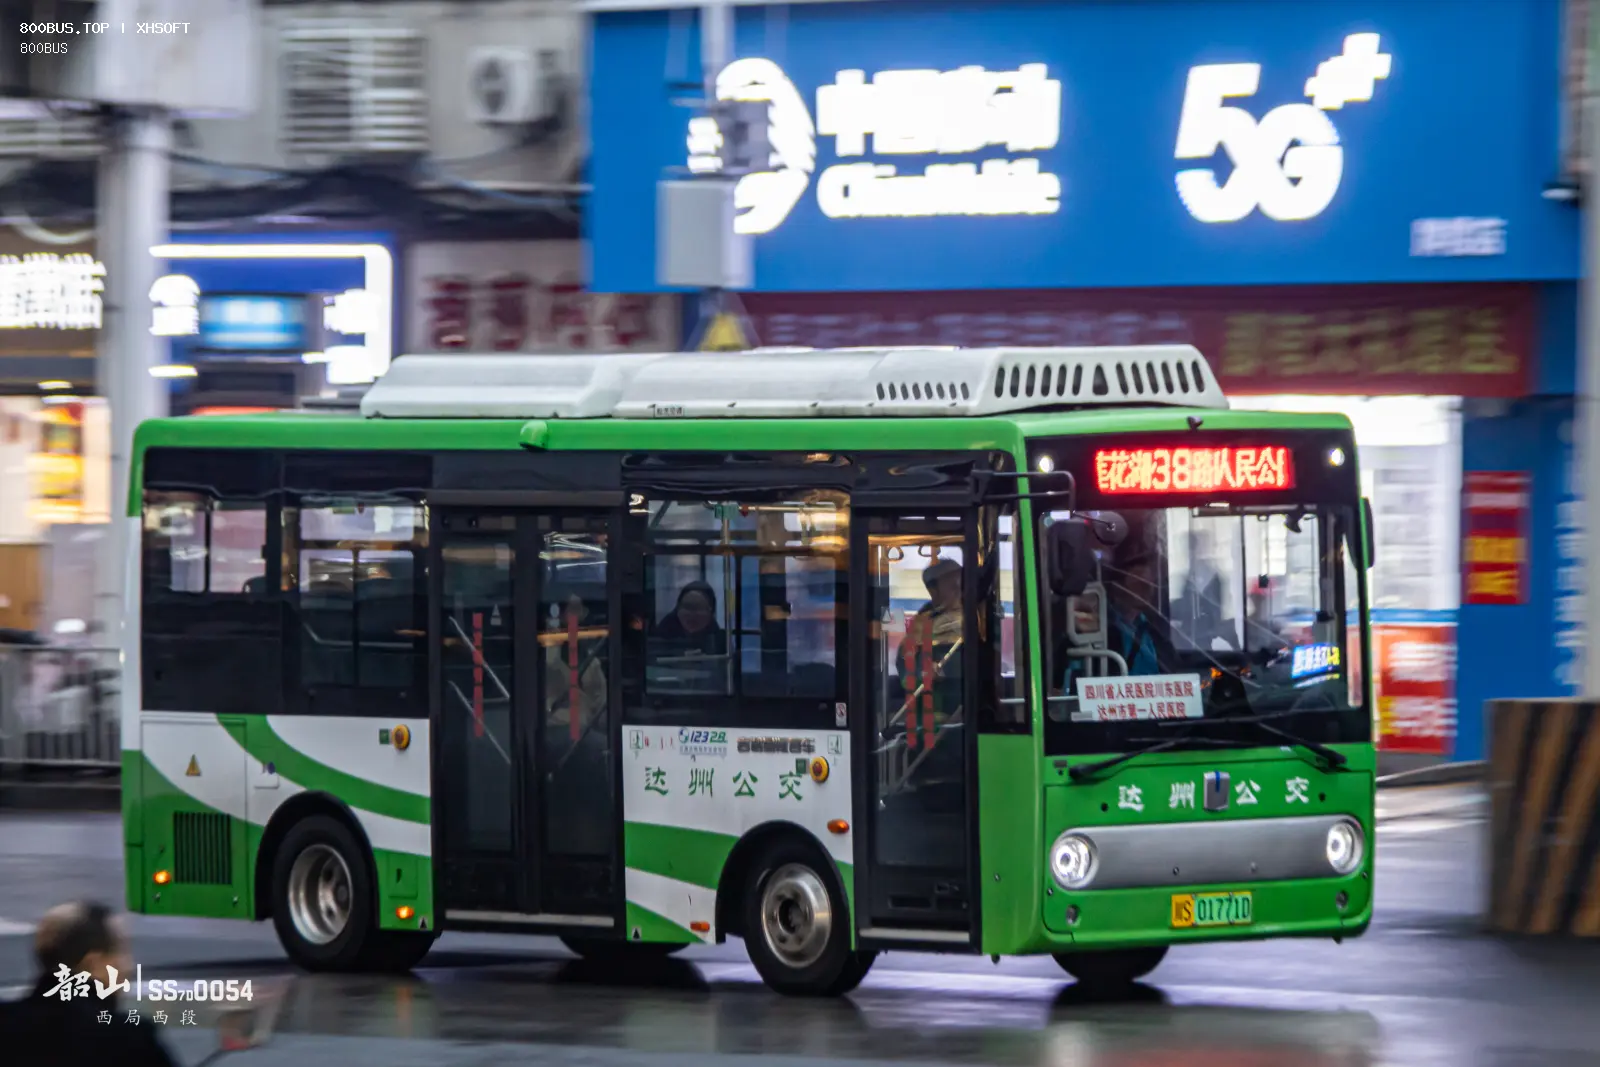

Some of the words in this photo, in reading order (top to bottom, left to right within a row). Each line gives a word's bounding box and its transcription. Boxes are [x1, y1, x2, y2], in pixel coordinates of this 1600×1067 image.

[1085, 681, 1194, 700] 四川省人民医院川东医院
[1097, 701, 1188, 720] 达州市第一人民医院
[690, 730, 728, 744] 12328
[644, 766, 803, 801] 达州公交
[1118, 776, 1310, 812] 达州公交
[1175, 896, 1250, 922] S01771D
